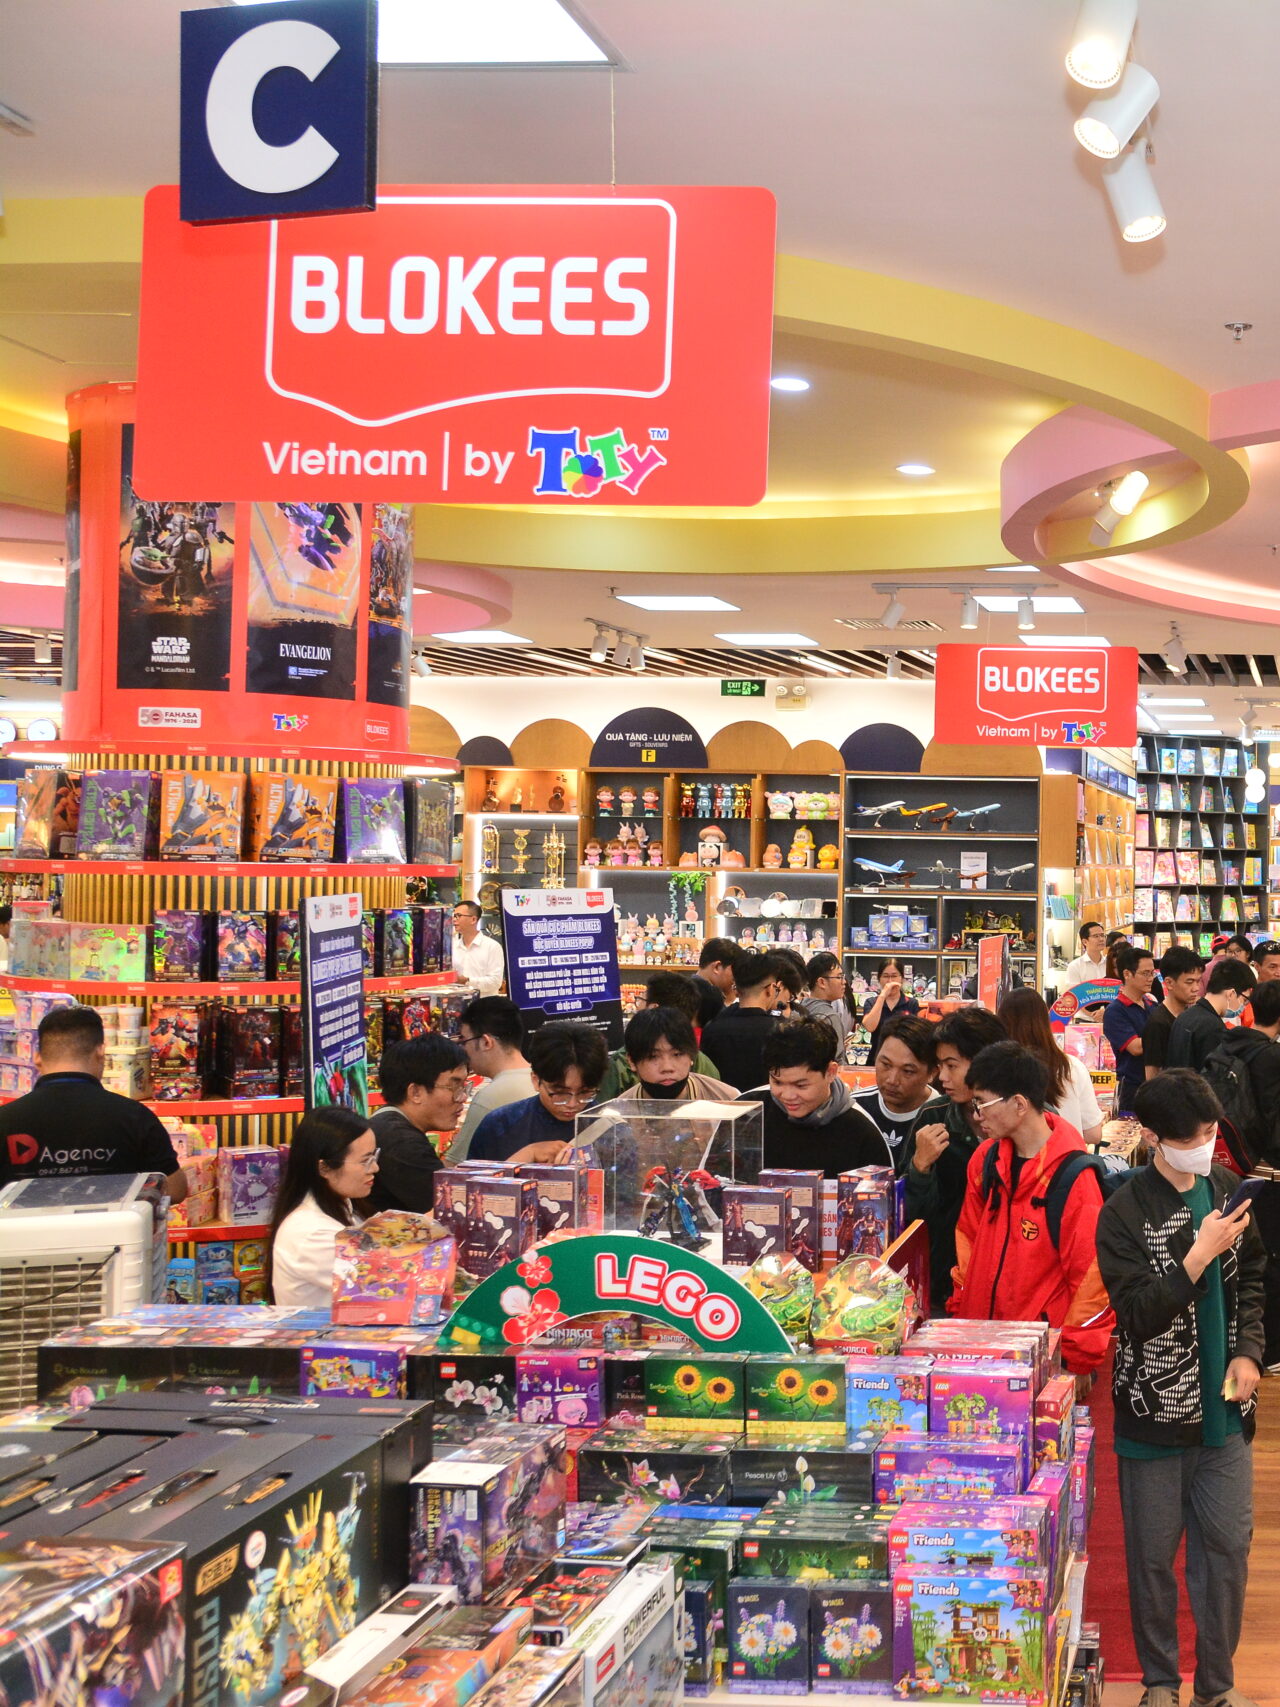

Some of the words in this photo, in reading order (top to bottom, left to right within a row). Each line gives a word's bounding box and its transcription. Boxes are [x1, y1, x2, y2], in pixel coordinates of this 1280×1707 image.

[205, 20, 341, 194] C
[289, 255, 650, 337] BLOKEES
[263, 440, 428, 478] Vietnam
[464, 441, 515, 485] by
[152, 637, 190, 645] STAR
[152, 645, 190, 654] WARS
[279, 643, 332, 661] EVANGELION
[984, 666, 1100, 693] BLOKEES
[366, 725, 389, 736] BLOKEES
[976, 725, 1030, 737] Vietnam
[1041, 725, 1058, 740] by
[646, 751, 653, 761] F
[40, 1146, 116, 1165] Agency
[595, 1252, 741, 1342] LEGO
[546, 1328, 593, 1340] NINJAGO
[853, 1377, 890, 1391] Friends
[764, 1472, 775, 1481] Lily
[892, 1536, 907, 1544] LEGO
[912, 1532, 954, 1546] Friends
[897, 1584, 912, 1592] LEGO
[918, 1582, 960, 1596] Friends
[623, 1584, 666, 1644] POWERFUL
